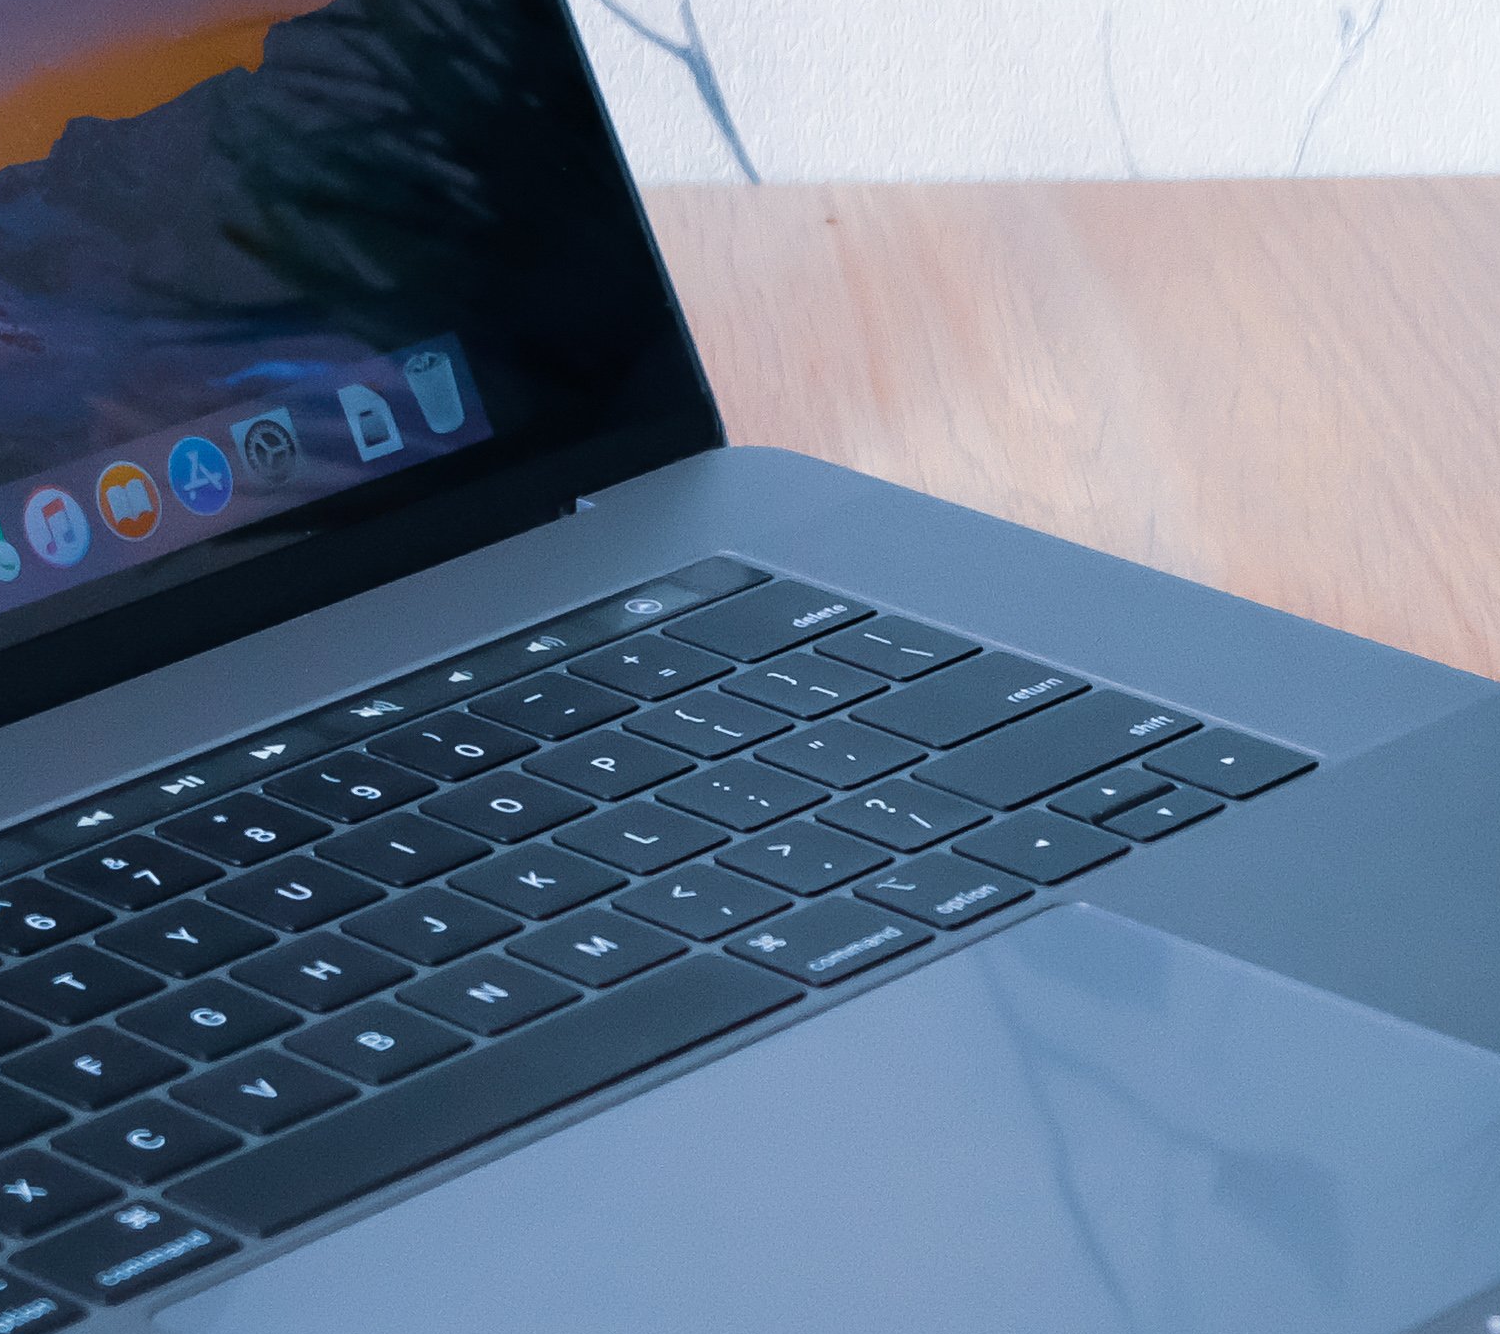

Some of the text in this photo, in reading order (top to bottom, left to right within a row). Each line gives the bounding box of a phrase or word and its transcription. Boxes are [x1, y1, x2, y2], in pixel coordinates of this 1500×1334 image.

[792, 604, 848, 628] delete
[1006, 678, 1063, 703] return
[1129, 715, 1174, 736] shift
[590, 756, 616, 772] P
[349, 784, 383, 800] 9
[489, 797, 524, 814] O
[243, 826, 277, 843] 8
[623, 831, 660, 845] L
[132, 868, 162, 886] 7
[518, 870, 557, 889] K
[275, 881, 313, 901] U
[23, 913, 57, 931] 6
[422, 915, 448, 933] J
[165, 926, 199, 945] Y
[574, 935, 618, 957] M
[300, 959, 342, 981] H
[52, 972, 87, 991] T
[467, 982, 509, 1004] N
[189, 1007, 228, 1027] G
[356, 1031, 396, 1052] B
[241, 1078, 278, 1099] V
[125, 1128, 166, 1150] C
[3, 1178, 48, 1203] X
